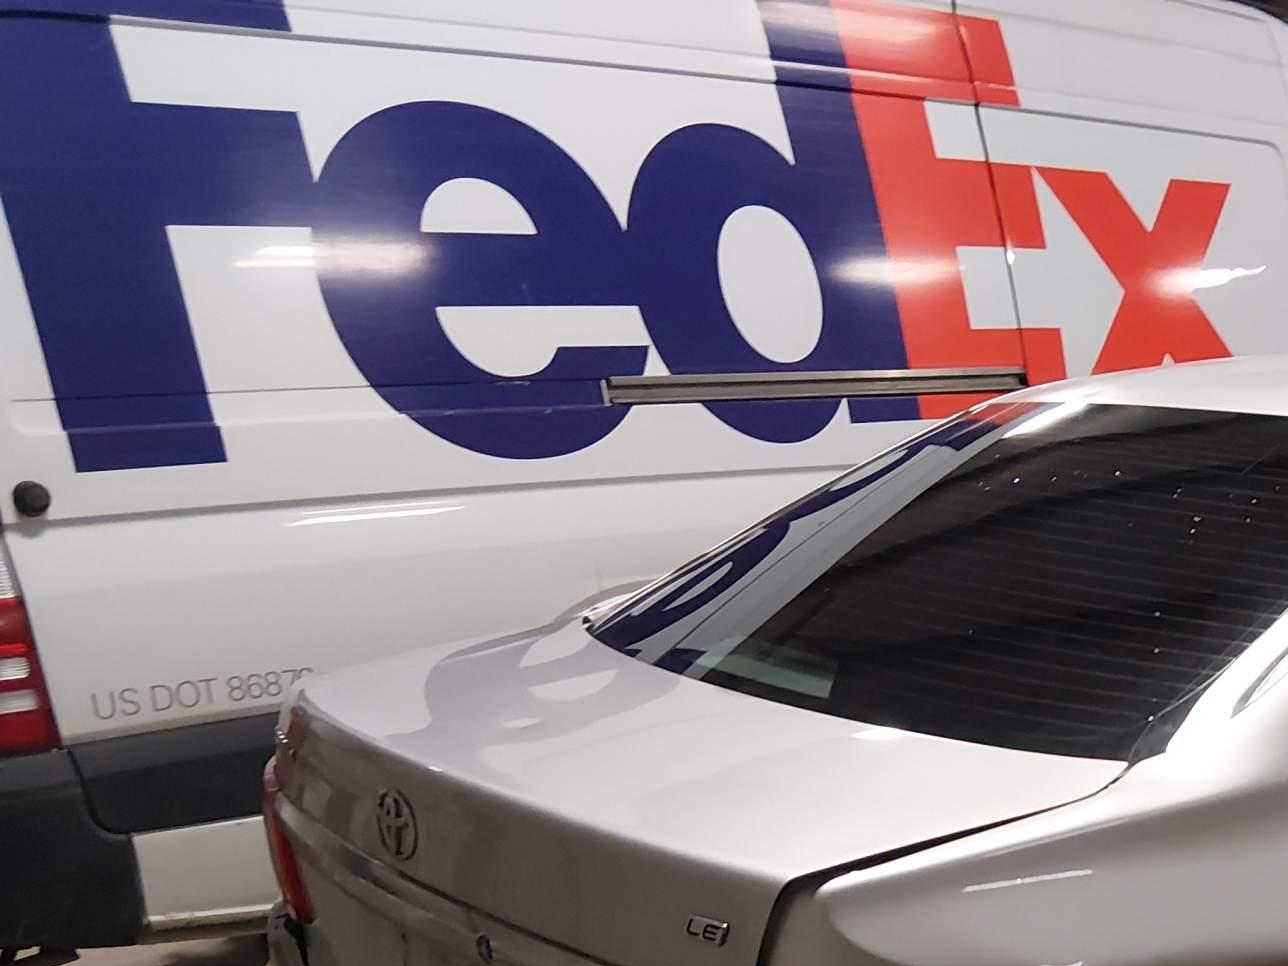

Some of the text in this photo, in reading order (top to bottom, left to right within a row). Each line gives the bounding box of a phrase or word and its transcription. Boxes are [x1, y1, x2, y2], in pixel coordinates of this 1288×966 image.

[0, 0, 1231, 472] FedEx
[89, 666, 314, 721] US DOT 8687
[686, 917, 724, 943] LE
